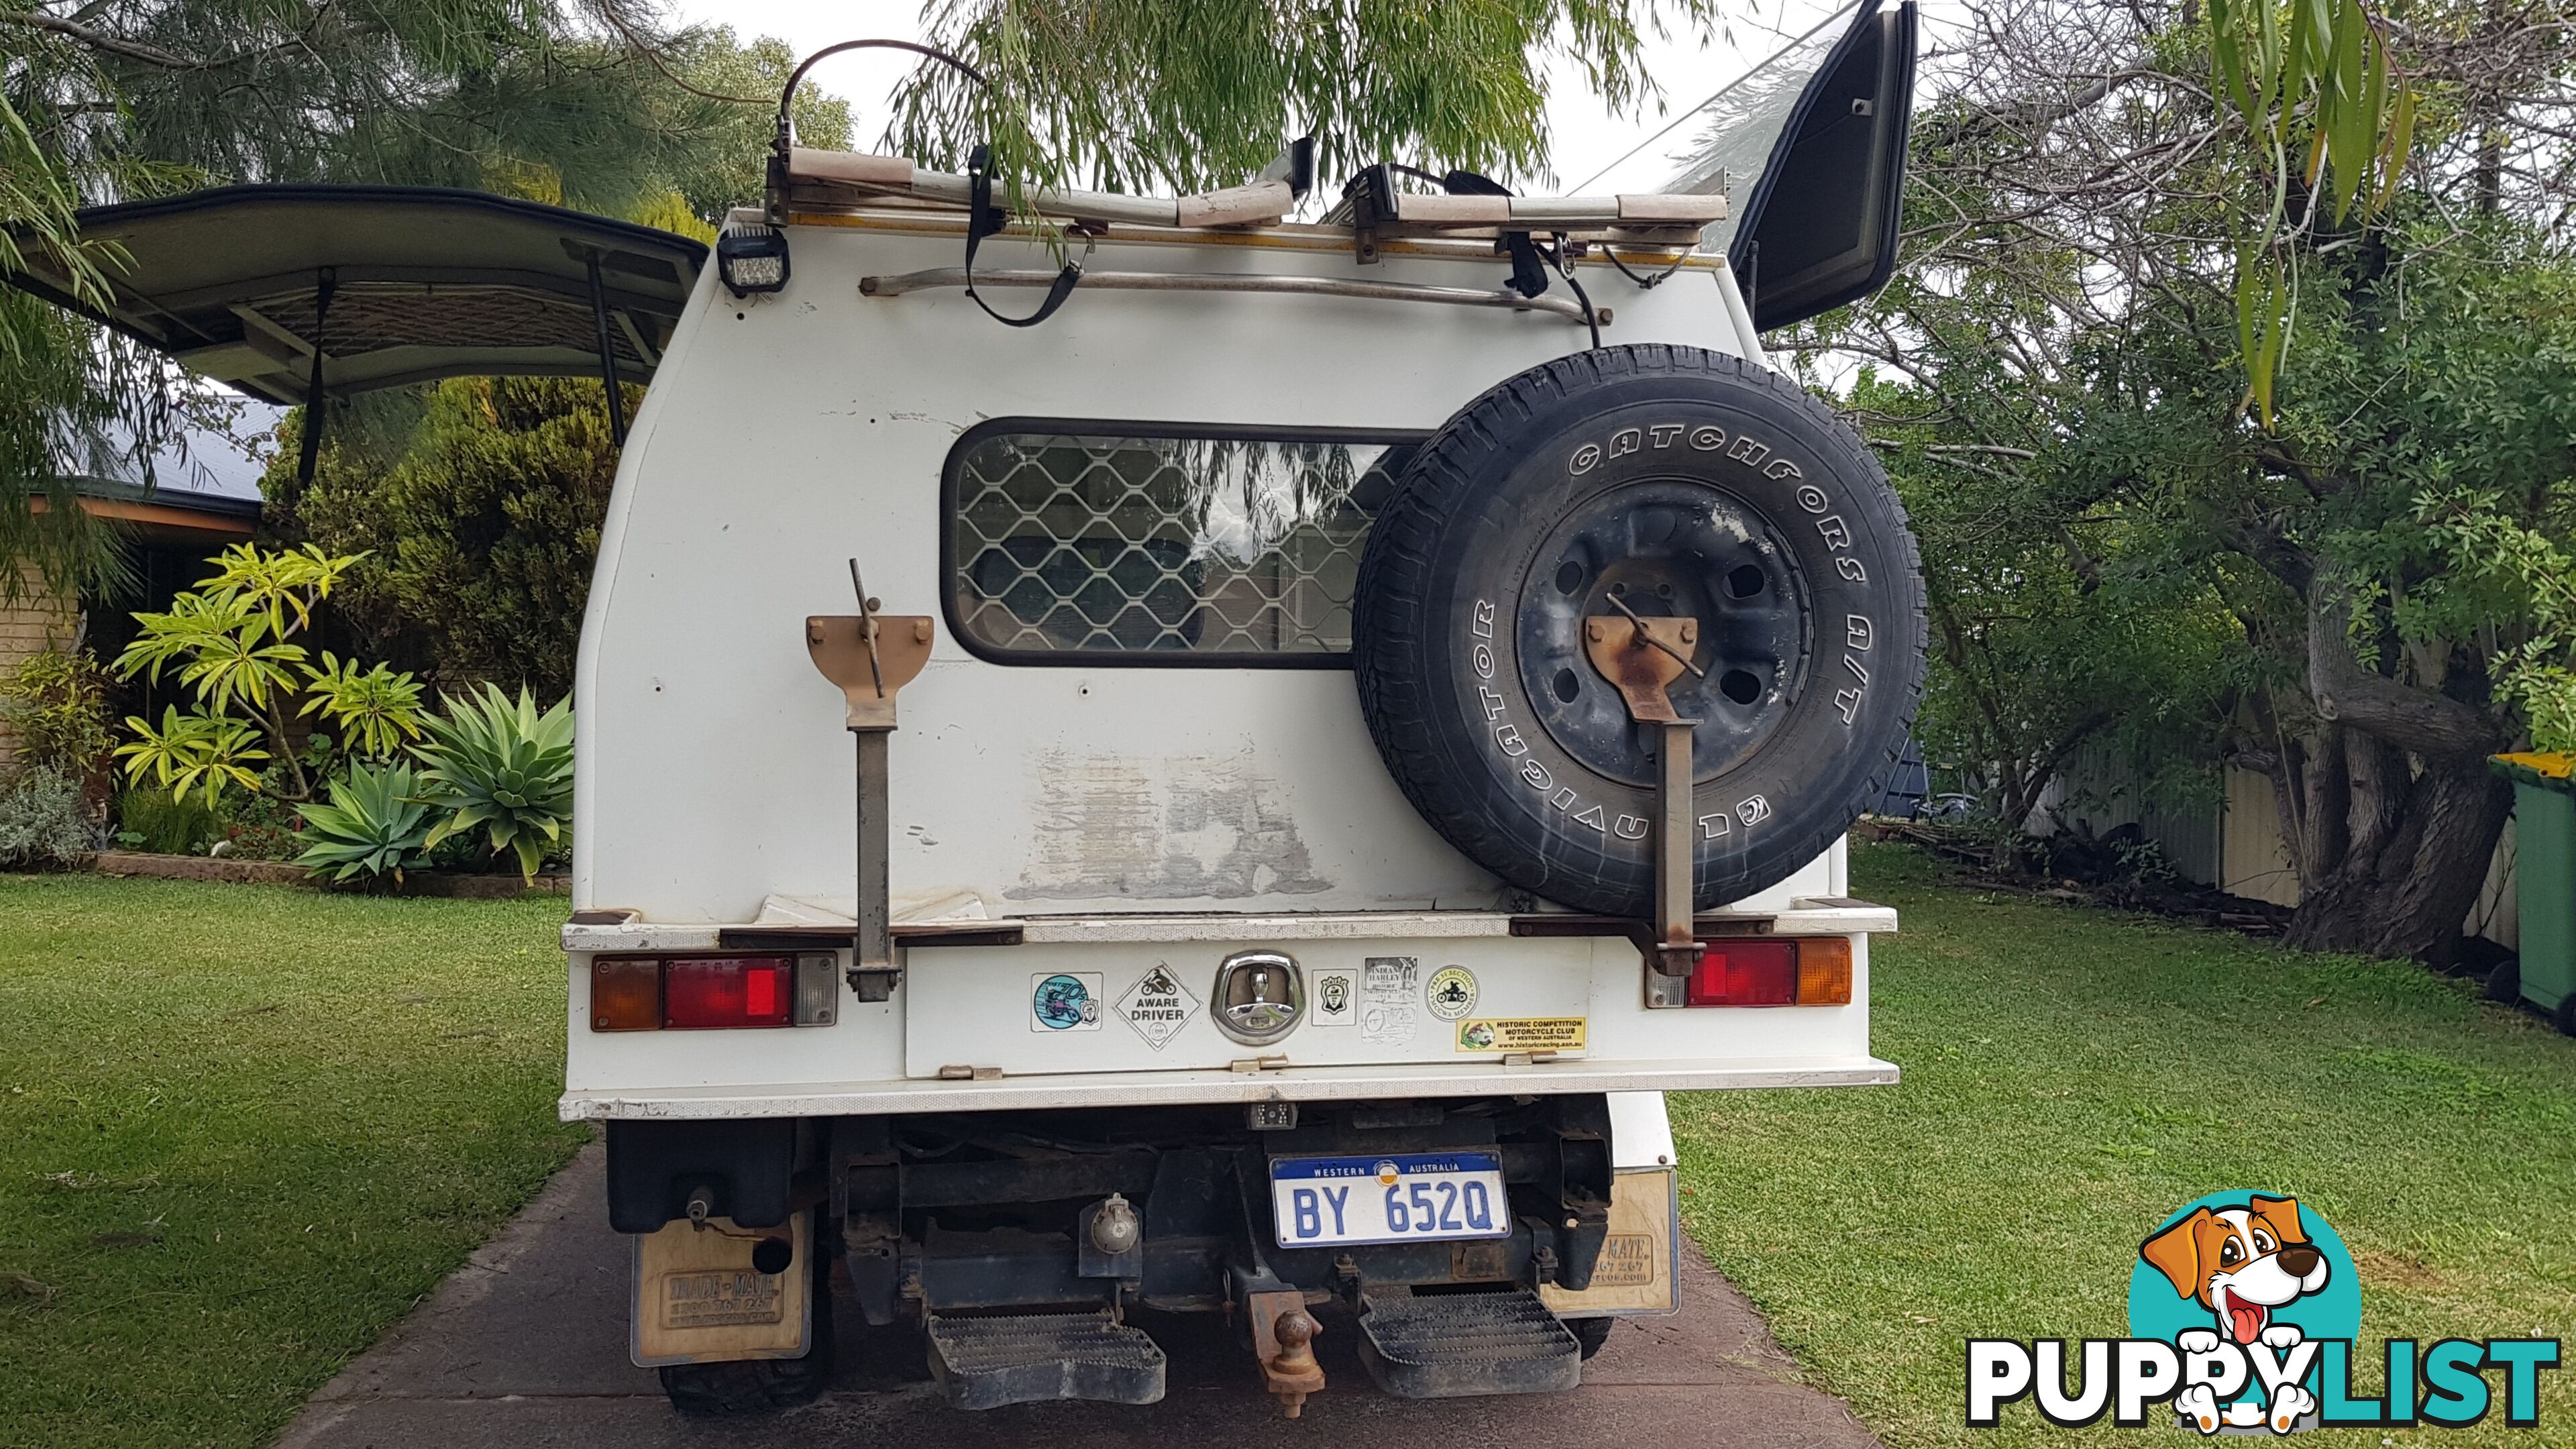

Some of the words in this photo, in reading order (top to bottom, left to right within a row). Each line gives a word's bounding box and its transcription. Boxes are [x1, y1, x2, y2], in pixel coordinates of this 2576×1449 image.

[1568, 423, 1866, 583] CATCHFORS
[1833, 614, 1874, 726] A/T
[1472, 600, 1729, 840] LNVIGATOR
[1431, 977, 1440, 989] PRE
[1448, 970, 1474, 988] SECTION
[1136, 998, 1179, 1008] AWARE
[1454, 992, 1475, 1016] MEMBER
[1131, 1010, 1184, 1020] DRIVER
[1314, 1167, 1365, 1177] WESTERN
[1409, 1163, 1460, 1173] AUSTRALIA
[1293, 1186, 1350, 1238] BY
[1385, 1181, 1493, 1234] 652Q
[1618, 1260, 1644, 1272] 267
[713, 1299, 741, 1311] 767
[745, 1297, 774, 1309] 267
